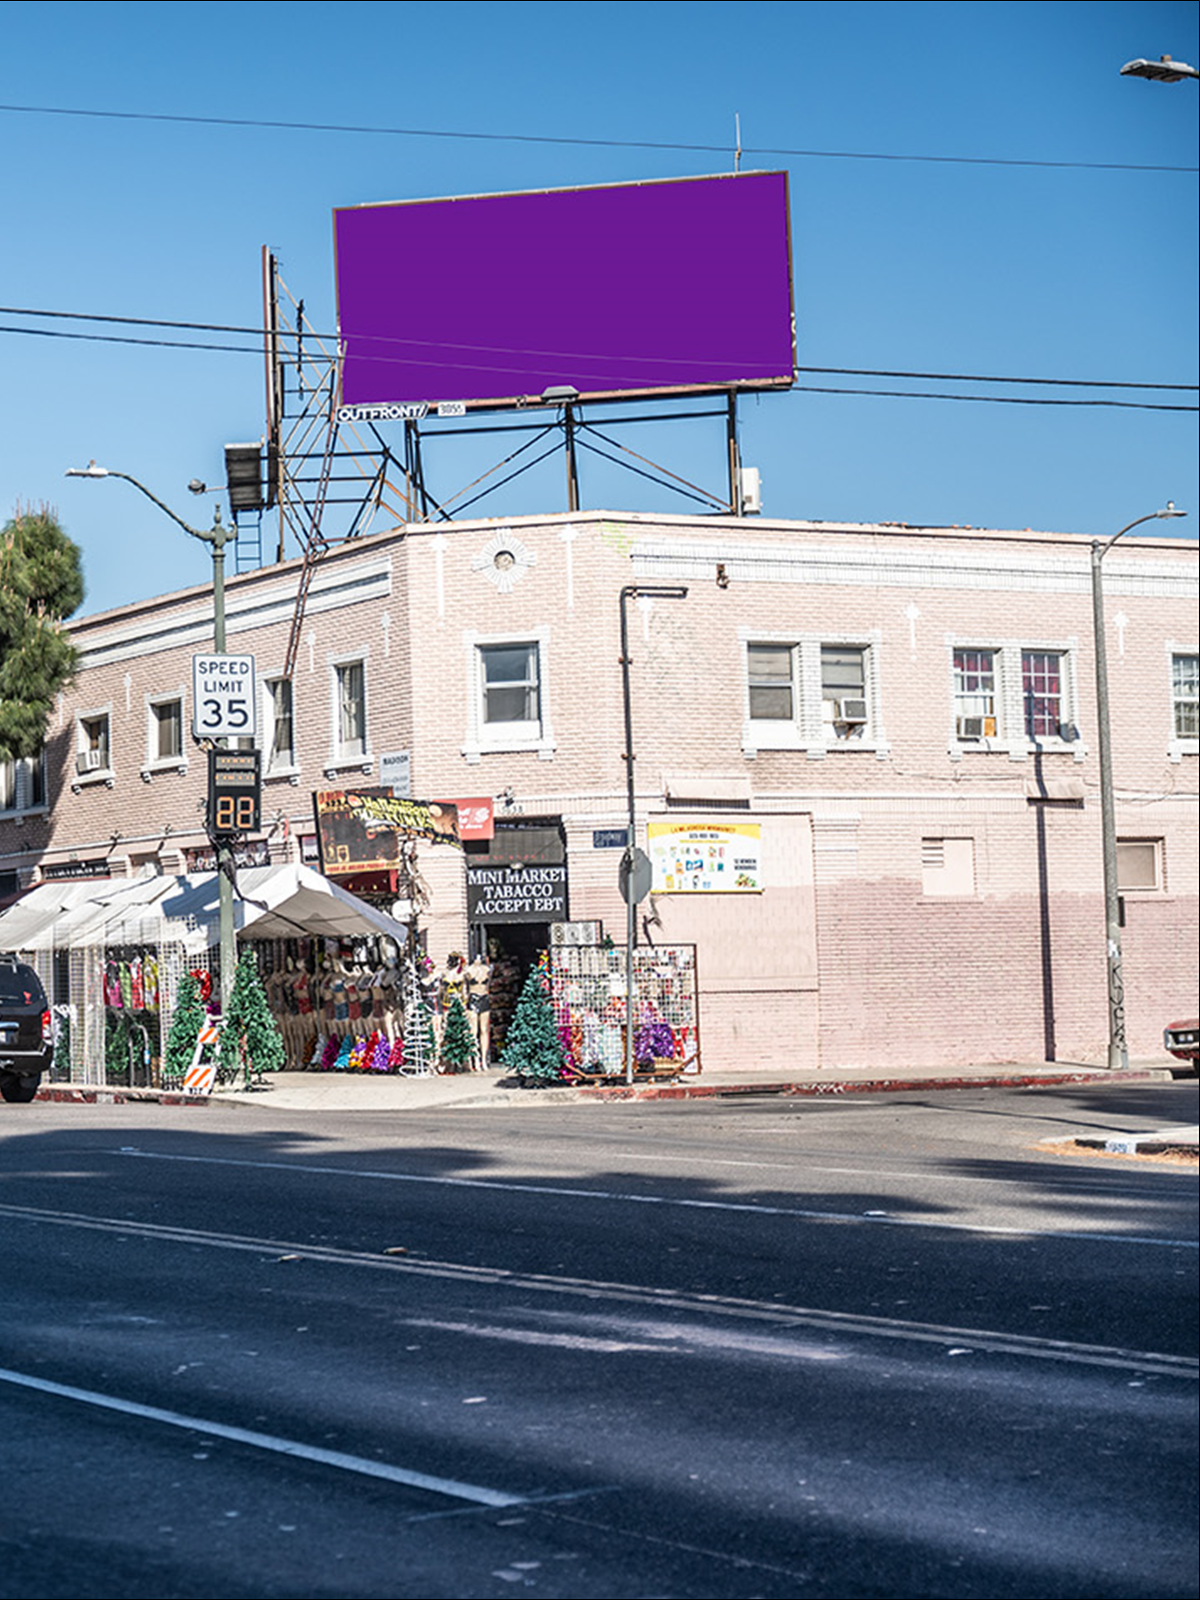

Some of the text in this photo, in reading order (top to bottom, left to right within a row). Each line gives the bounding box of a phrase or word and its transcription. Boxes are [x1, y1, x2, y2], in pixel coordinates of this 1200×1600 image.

[198, 661, 250, 675] SPEED
[204, 680, 243, 693] LIMIT
[202, 698, 249, 728] 35
[468, 867, 566, 885] MINI MARKET
[483, 883, 553, 899] TABACCO
[475, 897, 563, 914] ACCEPT EBT
